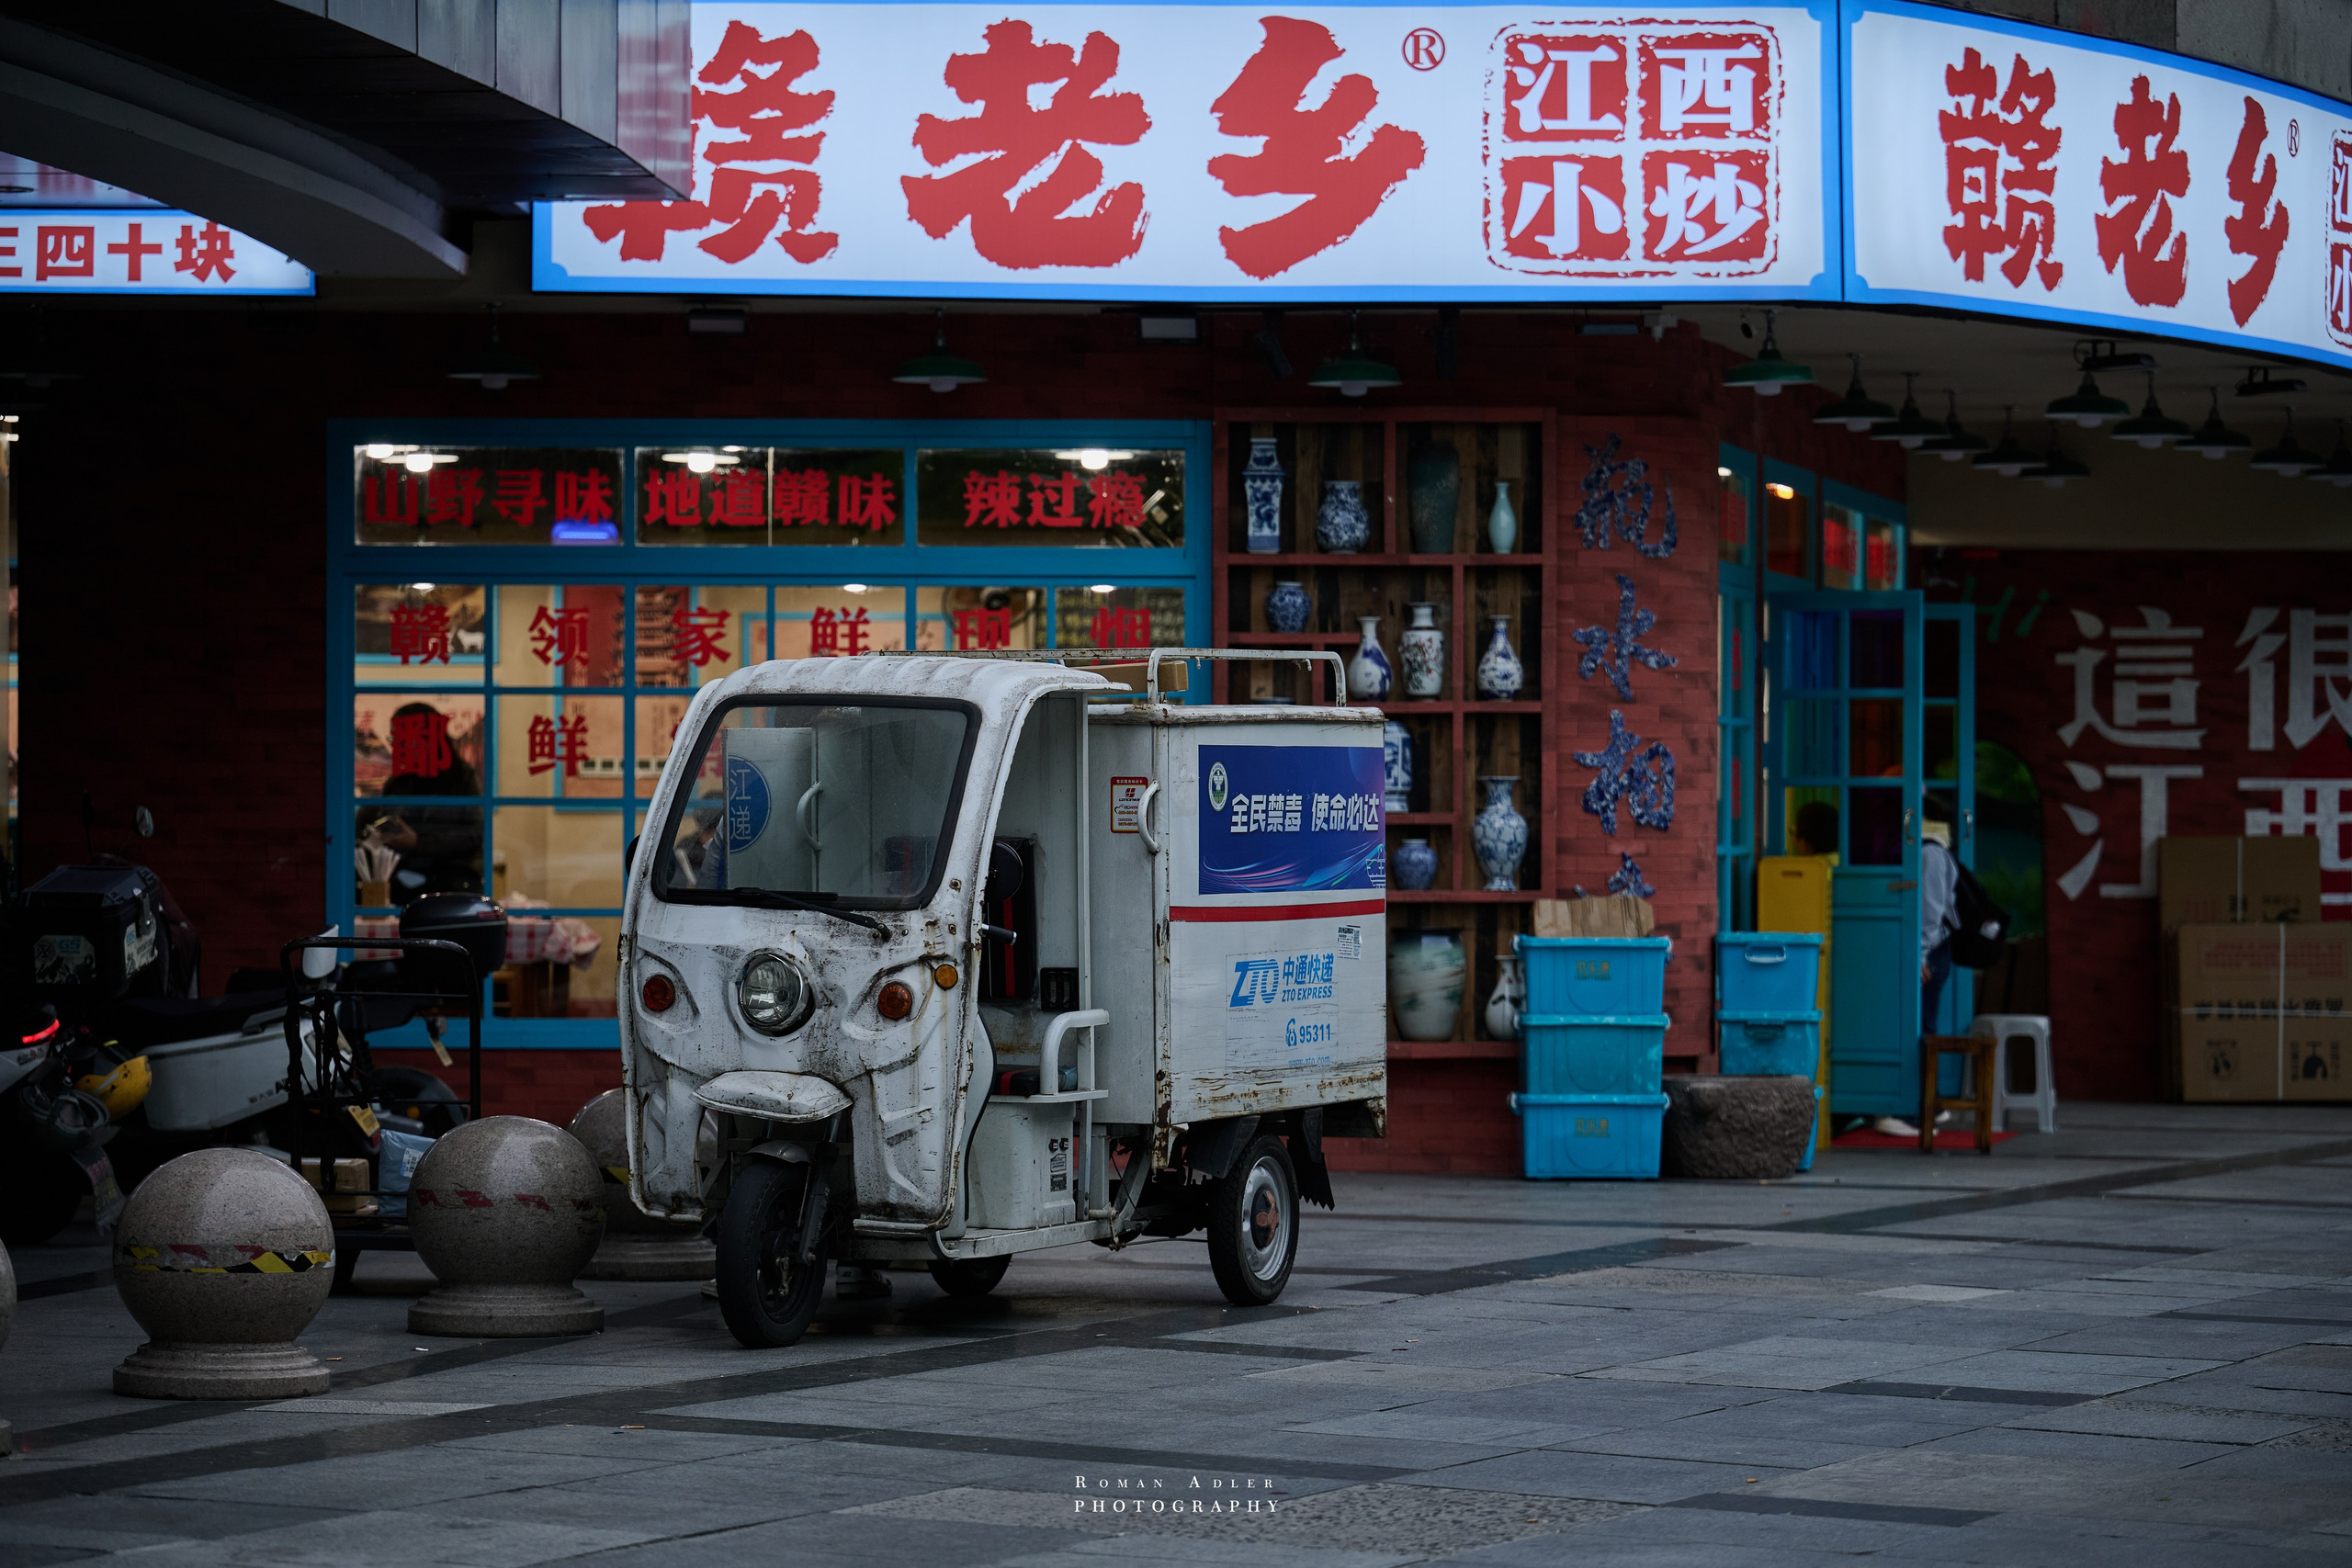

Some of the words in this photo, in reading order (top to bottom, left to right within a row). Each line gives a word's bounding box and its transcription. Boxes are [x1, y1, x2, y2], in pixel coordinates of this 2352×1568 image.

[1511, 43, 1764, 132] 江西
[583, 16, 1427, 280] 赣老乡
[1510, 161, 1765, 255] 小炒
[1939, 47, 2290, 328] 赣老乡
[365, 467, 613, 526] 山野寻味
[643, 468, 896, 530] 地道赣味
[963, 469, 1148, 528] 辣过瘾
[528, 605, 590, 666] 领
[672, 607, 732, 666] 家
[528, 714, 589, 776] 鲜
[1230, 793, 1303, 833] 全民禁毒
[1311, 793, 1380, 832] 使命必达
[1229, 958, 1280, 1008] ZTO
[1281, 987, 1296, 1003] ZTO
[1297, 985, 1333, 1001] EXPRESS
[1283, 953, 1334, 987] 中通快递
[1299, 1023, 1331, 1043] 95311
